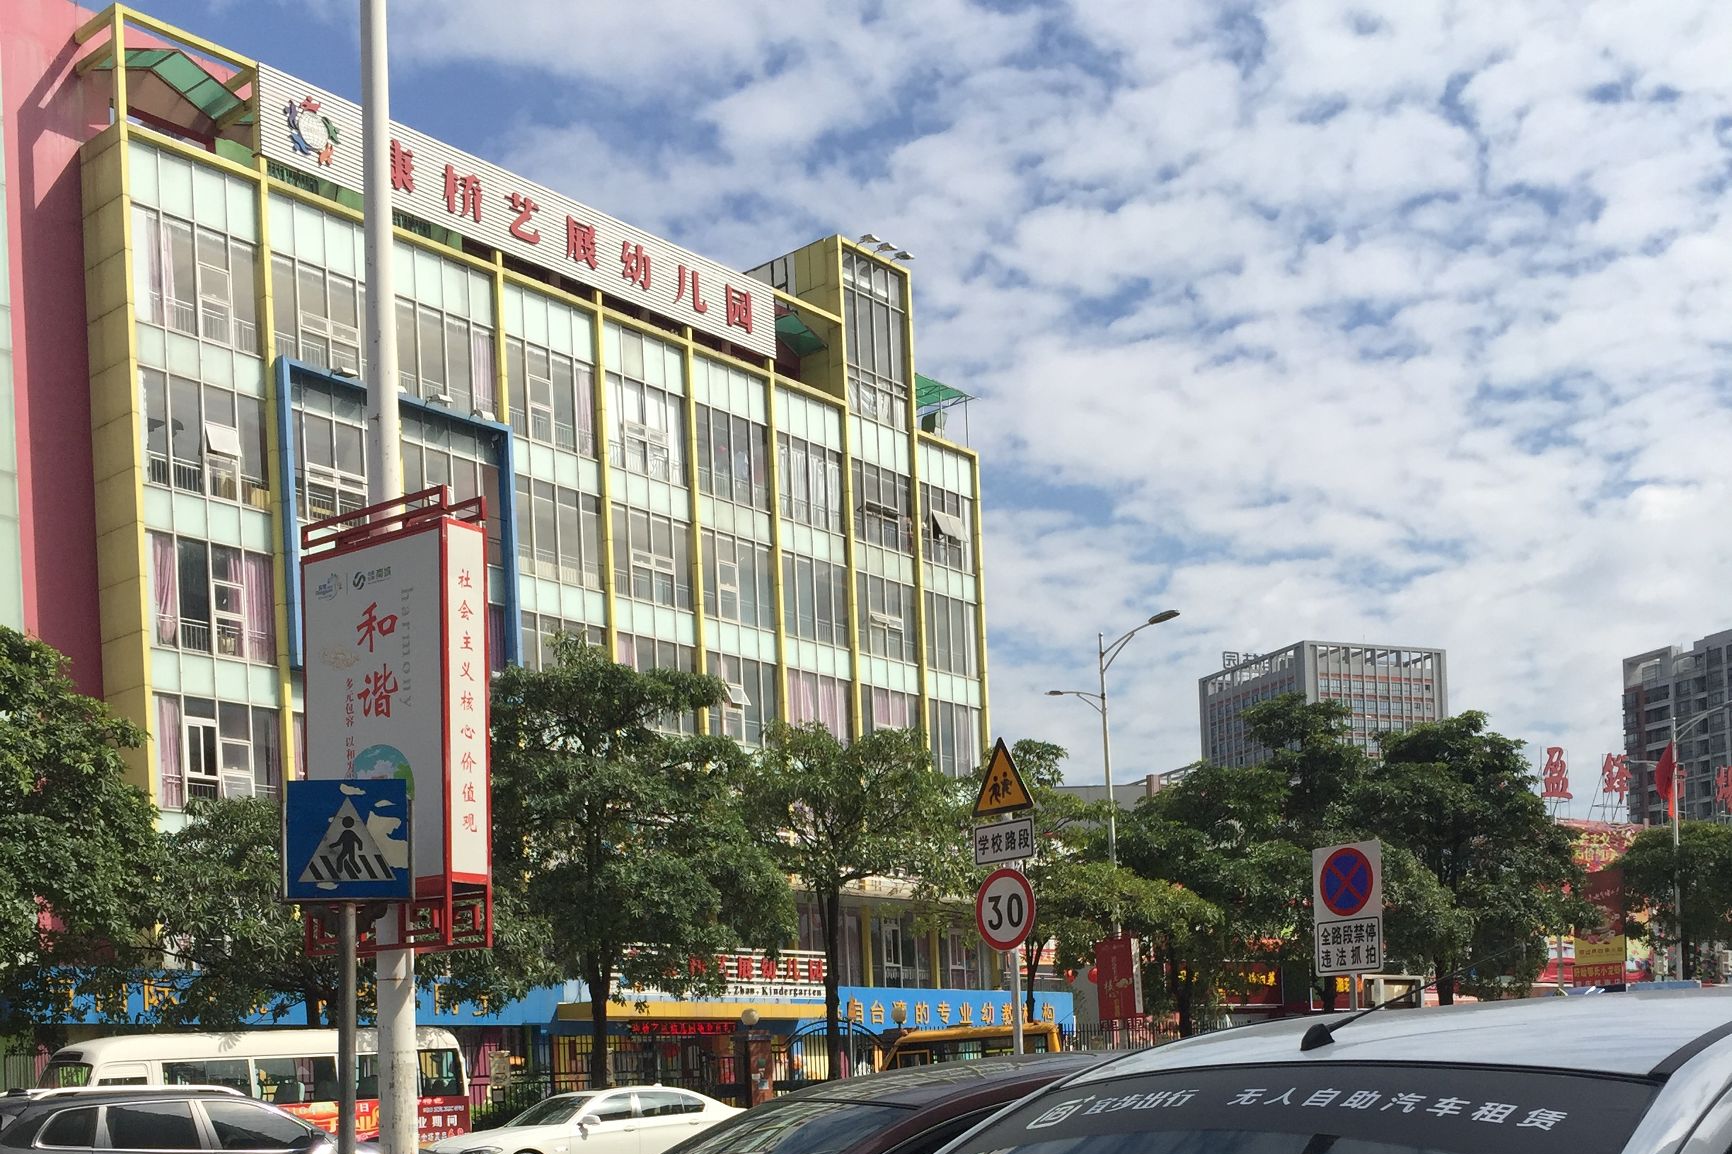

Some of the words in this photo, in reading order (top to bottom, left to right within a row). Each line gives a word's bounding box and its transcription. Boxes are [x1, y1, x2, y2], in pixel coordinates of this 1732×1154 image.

[356, 601, 398, 718] 和谐
[400, 587, 414, 708] harmony
[457, 568, 477, 833] 社会主义核心价值观
[978, 828, 1030, 856] 学校路段
[988, 893, 1023, 931] 30
[1320, 923, 1377, 946] 全路段禁停
[1320, 945, 1377, 968] 违法抓拍
[761, 986, 823, 997] Kindergarten
[1227, 1087, 1568, 1132] 无人自助汽车租赁
